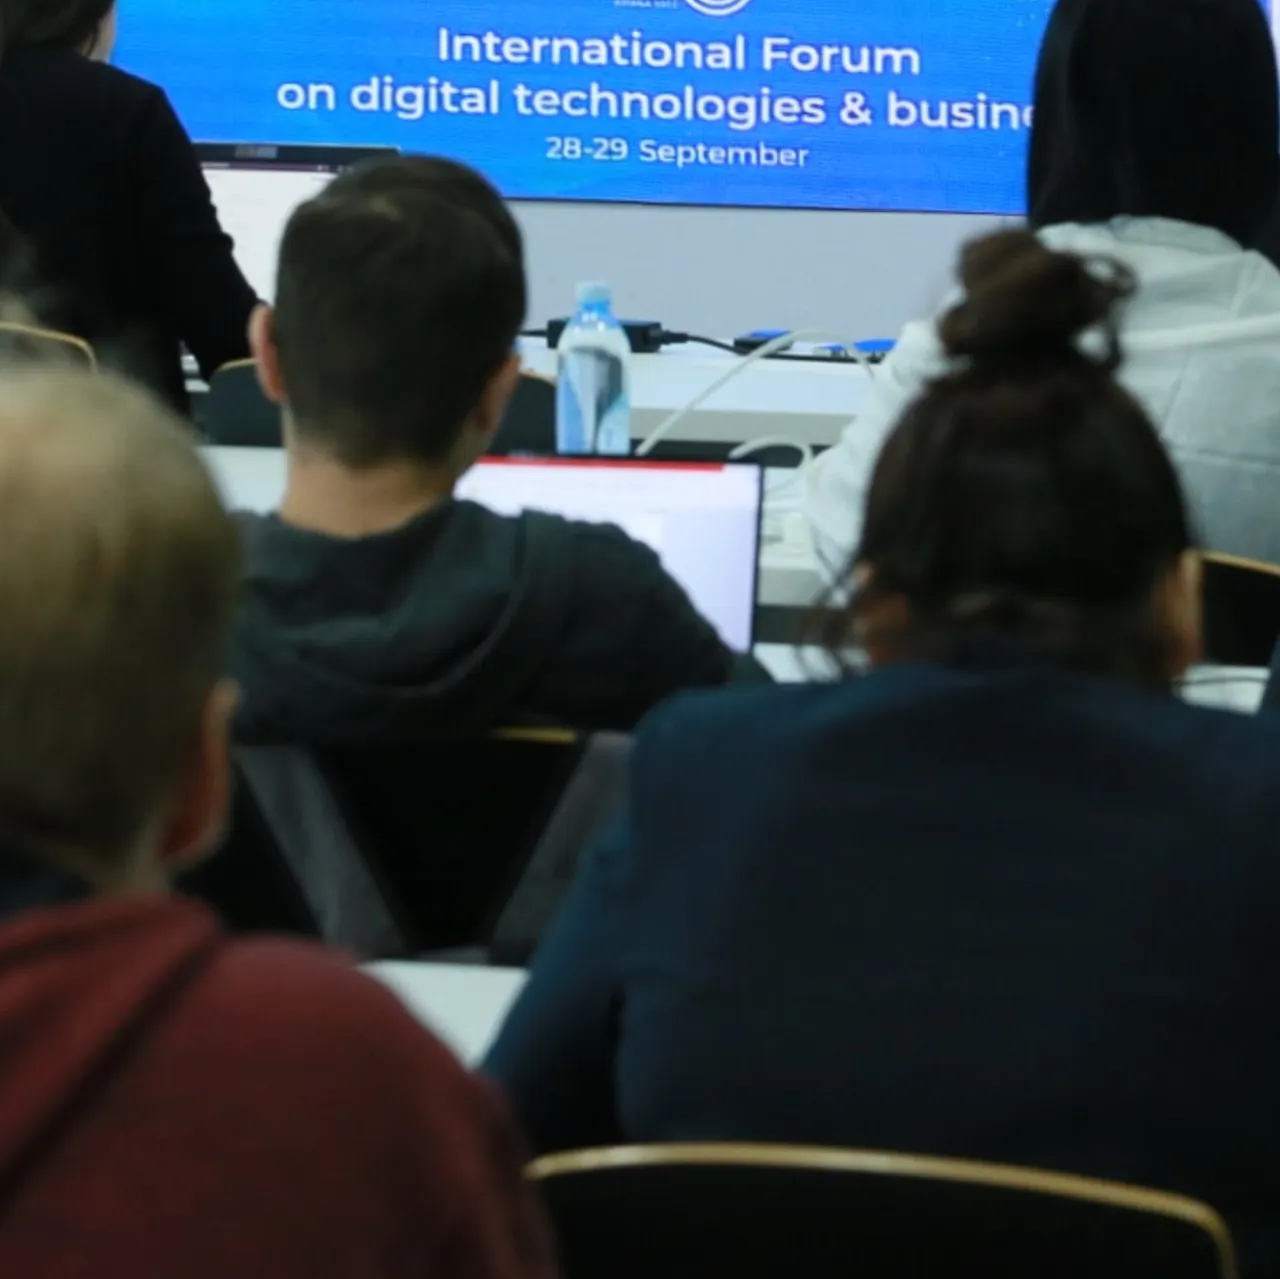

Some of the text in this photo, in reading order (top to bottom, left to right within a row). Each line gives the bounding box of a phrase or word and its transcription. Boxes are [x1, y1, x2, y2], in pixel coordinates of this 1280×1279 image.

[438, 26, 921, 76] International Forum
[276, 82, 337, 112] on
[349, 74, 501, 121] digital
[512, 80, 828, 132] technologies
[838, 90, 873, 127] &
[545, 135, 811, 169] 28-29 September
